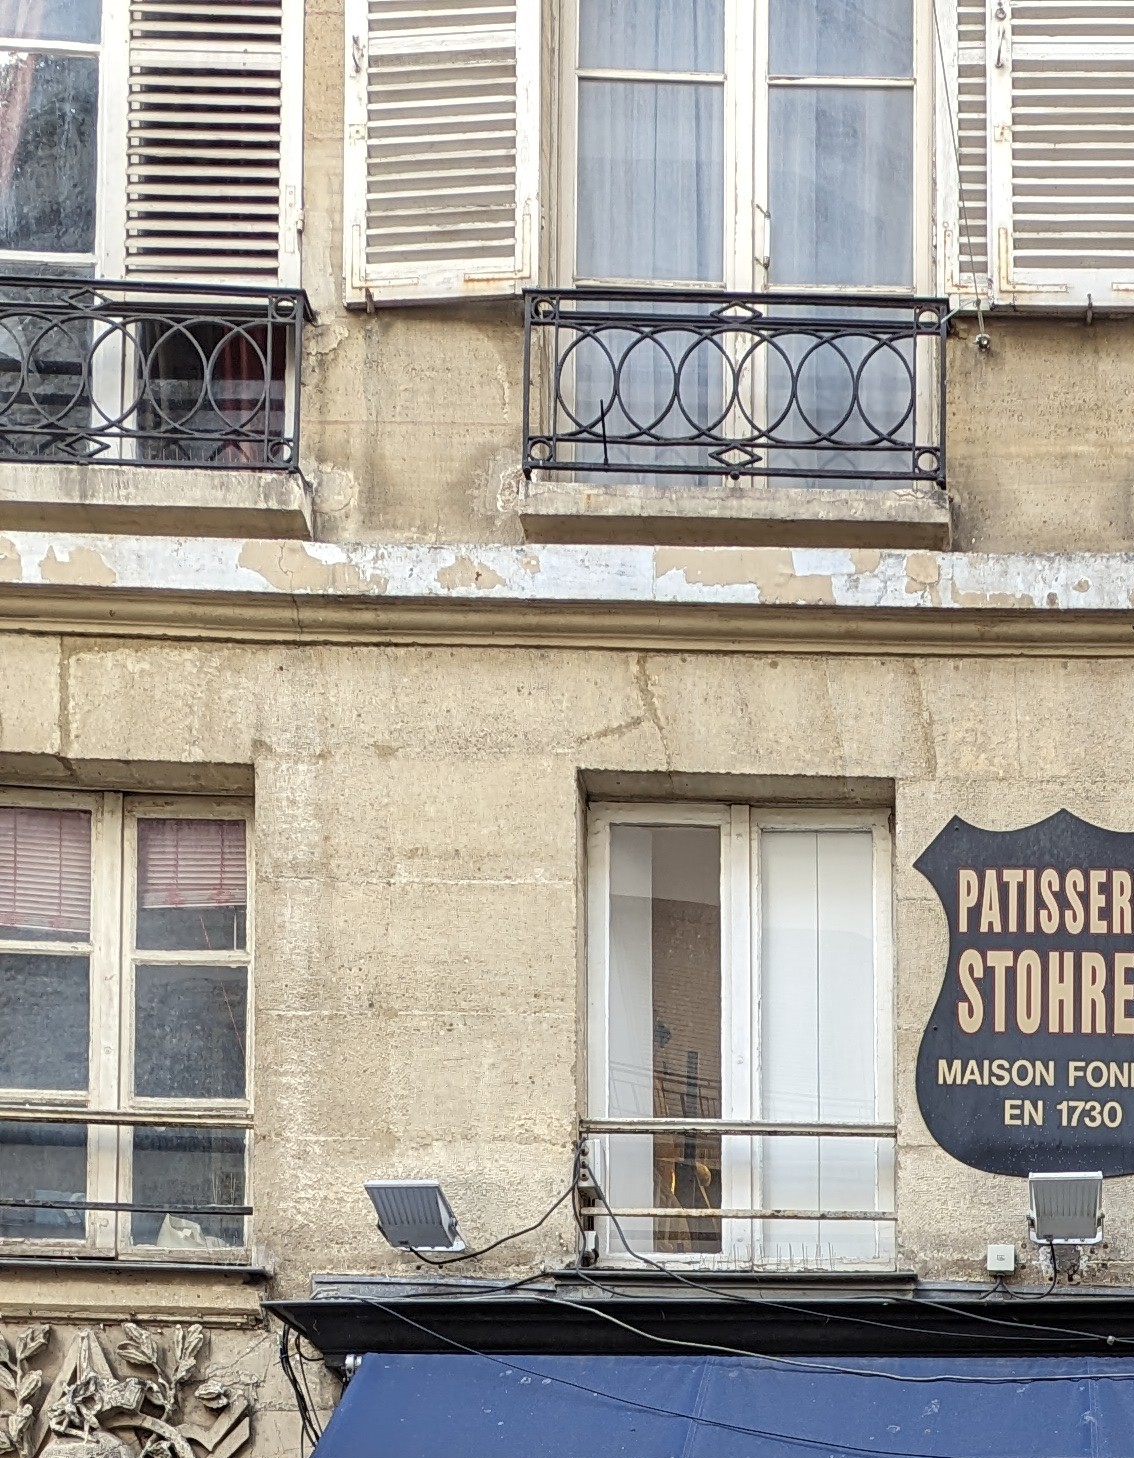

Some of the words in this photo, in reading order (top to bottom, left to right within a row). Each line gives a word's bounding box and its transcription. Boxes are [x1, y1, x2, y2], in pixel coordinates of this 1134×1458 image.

[937, 1059, 1054, 1087] MAISON
[1004, 1100, 1043, 1126] EN
[1056, 1101, 1123, 1128] 1730
